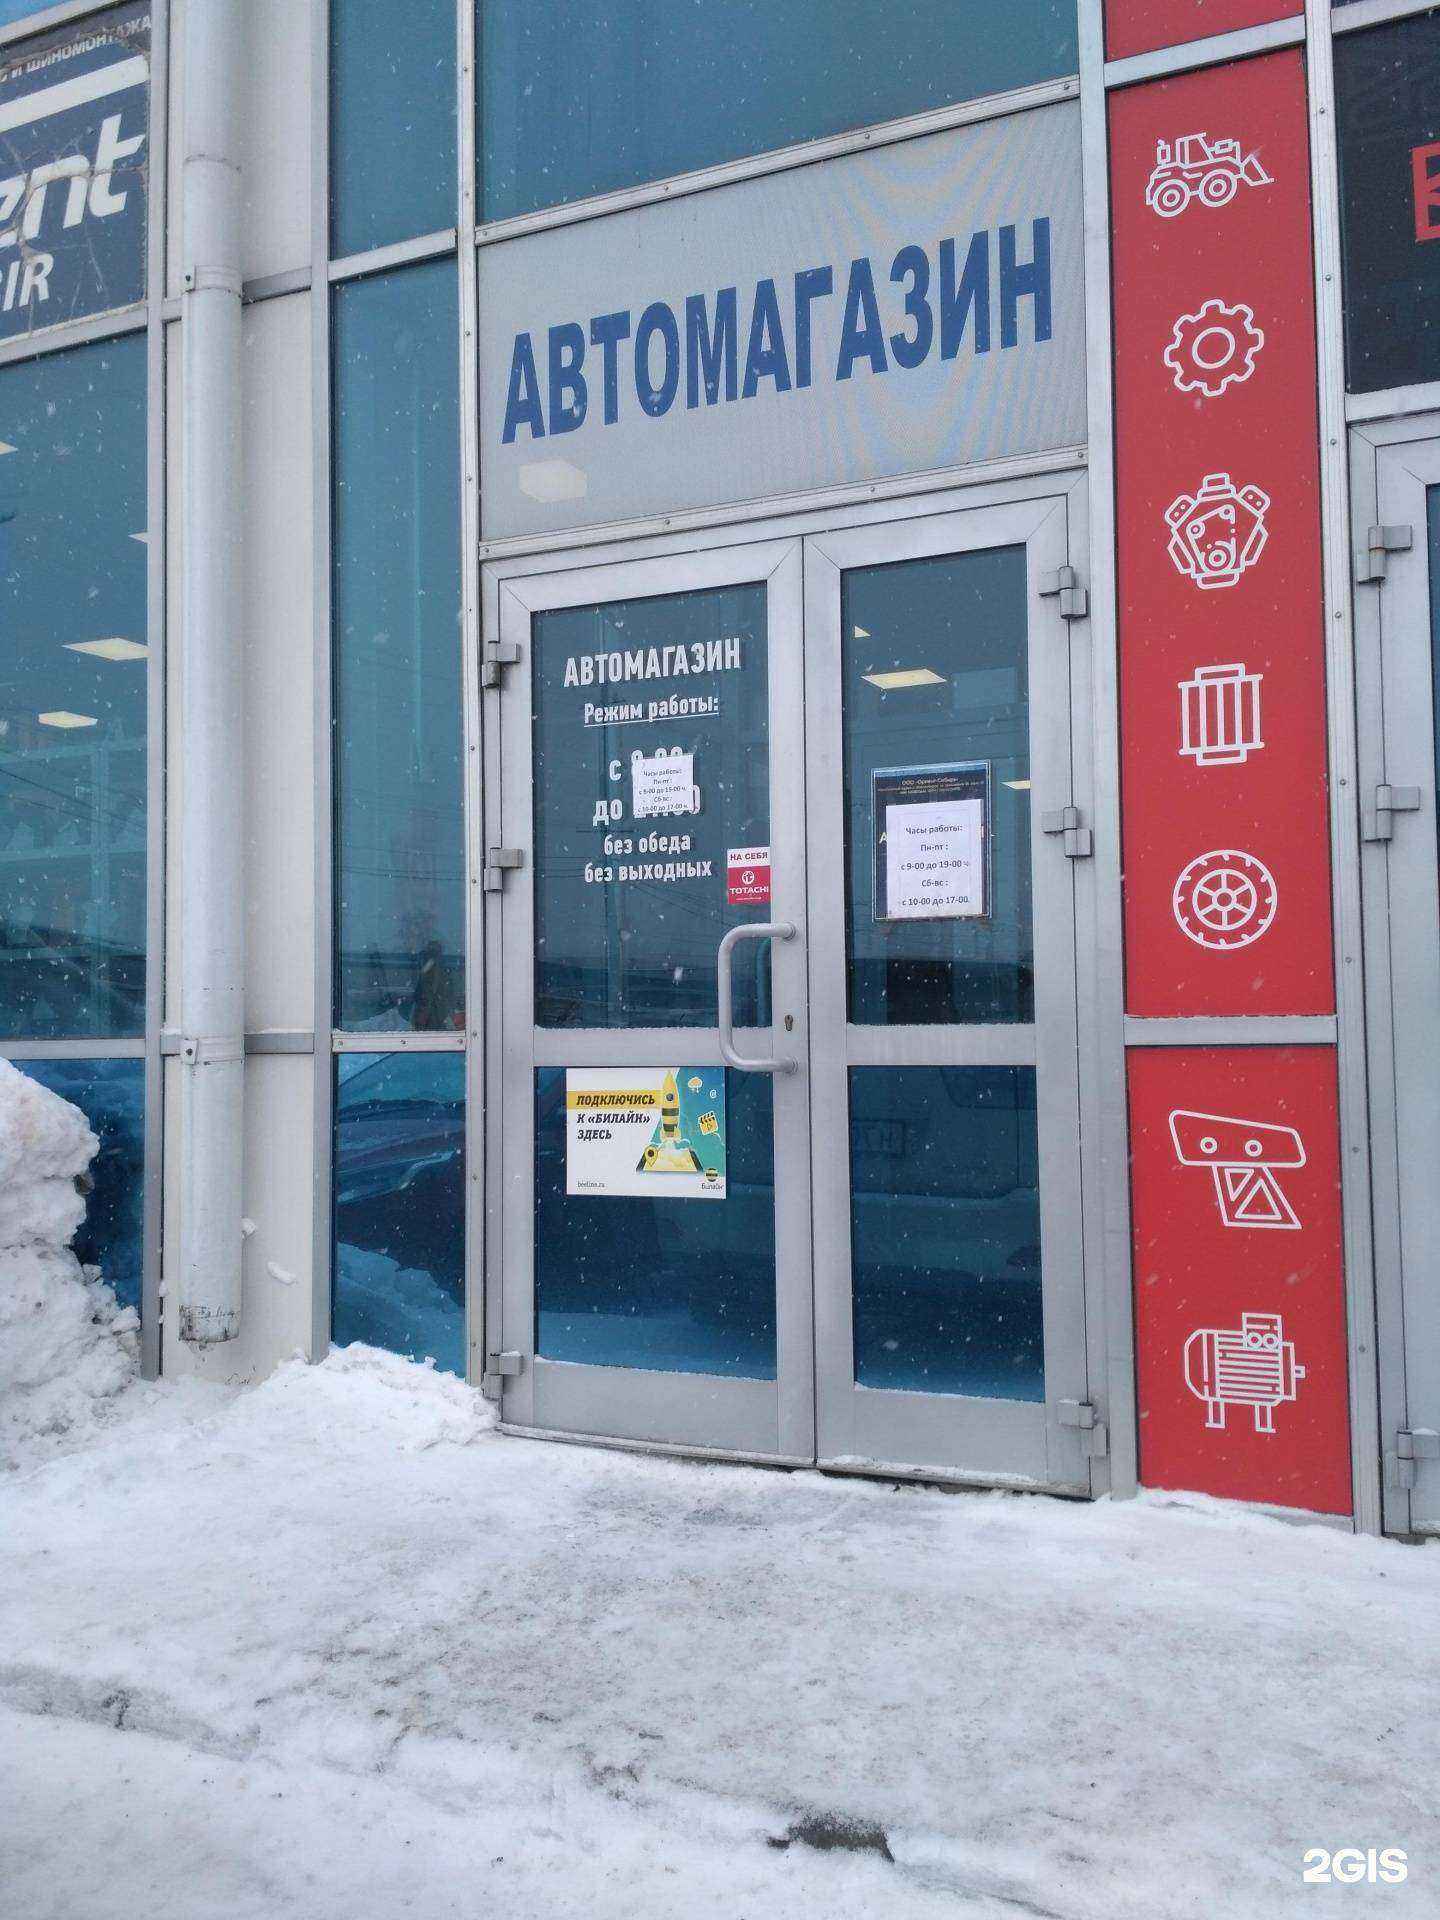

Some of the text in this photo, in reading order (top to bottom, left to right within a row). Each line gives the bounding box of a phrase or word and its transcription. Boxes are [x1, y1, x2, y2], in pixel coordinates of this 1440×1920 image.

[0, 252, 54, 312] IR
[501, 216, 1053, 445] АВТОМАГАЗИН
[563, 637, 741, 688] АВТОМАГАЗИН
[583, 694, 719, 724] Режим работы:
[593, 799, 623, 826] до
[905, 824, 963, 835] Часы работы:
[604, 830, 691, 856] без обеда
[730, 852, 768, 861] НА СЕБЯ
[584, 860, 712, 883] без выходных
[906, 862, 925, 870] 9-00
[926, 863, 937, 871] до
[939, 860, 962, 869] 19-00
[729, 886, 769, 895] TOTACHI
[908, 897, 930, 906] 10-00
[932, 898, 944, 907] до
[576, 1094, 656, 1107] ПОДКЛЮЧИСЬ
[587, 1110, 651, 1124] «БИЛАЙН»
[577, 1129, 613, 1142] ЗДЕСЬ
[577, 1180, 605, 1188] beeline.ru
